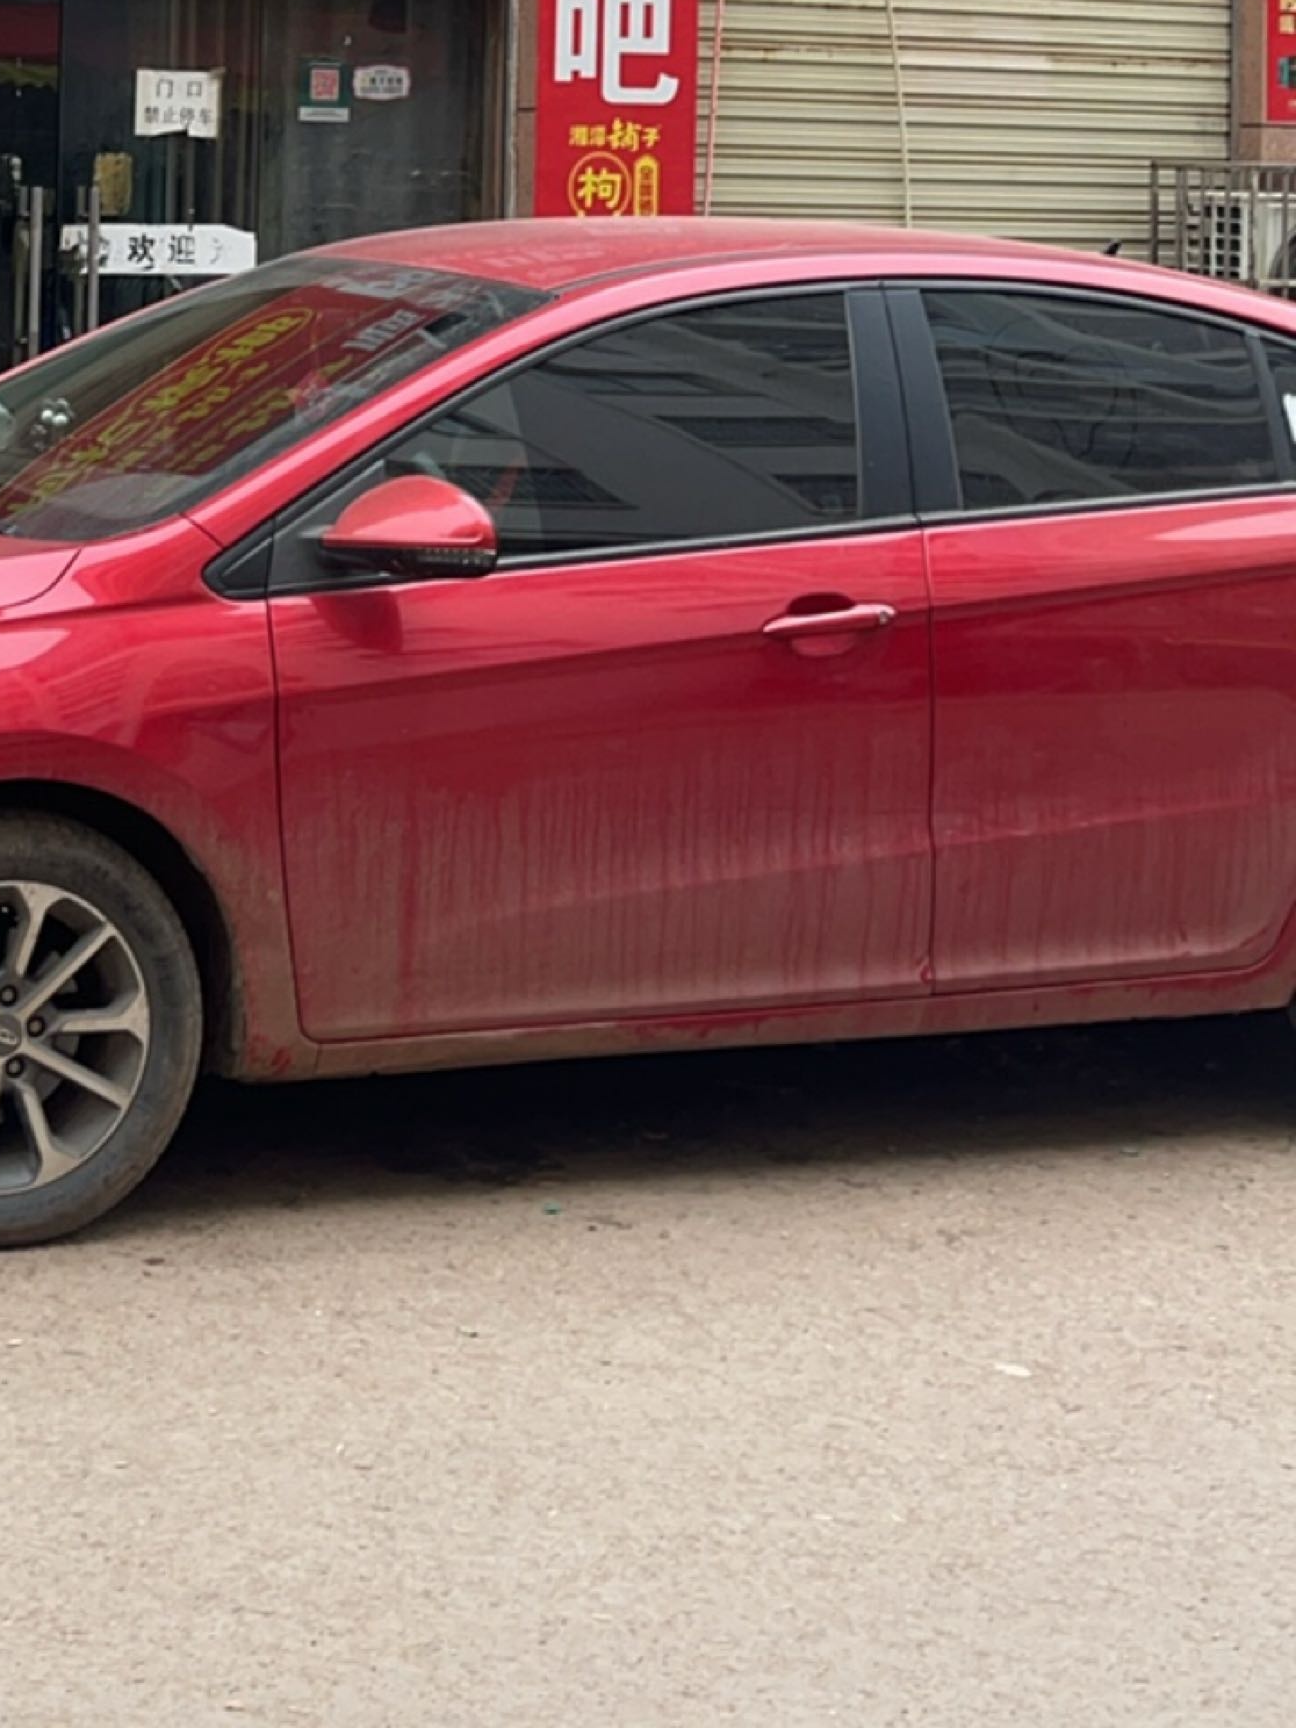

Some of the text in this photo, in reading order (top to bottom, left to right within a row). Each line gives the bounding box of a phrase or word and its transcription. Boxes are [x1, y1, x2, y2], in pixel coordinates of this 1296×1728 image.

[156, 78, 202, 98] 门口
[144, 105, 212, 126] 禁止停车
[576, 165, 623, 209] 枸
